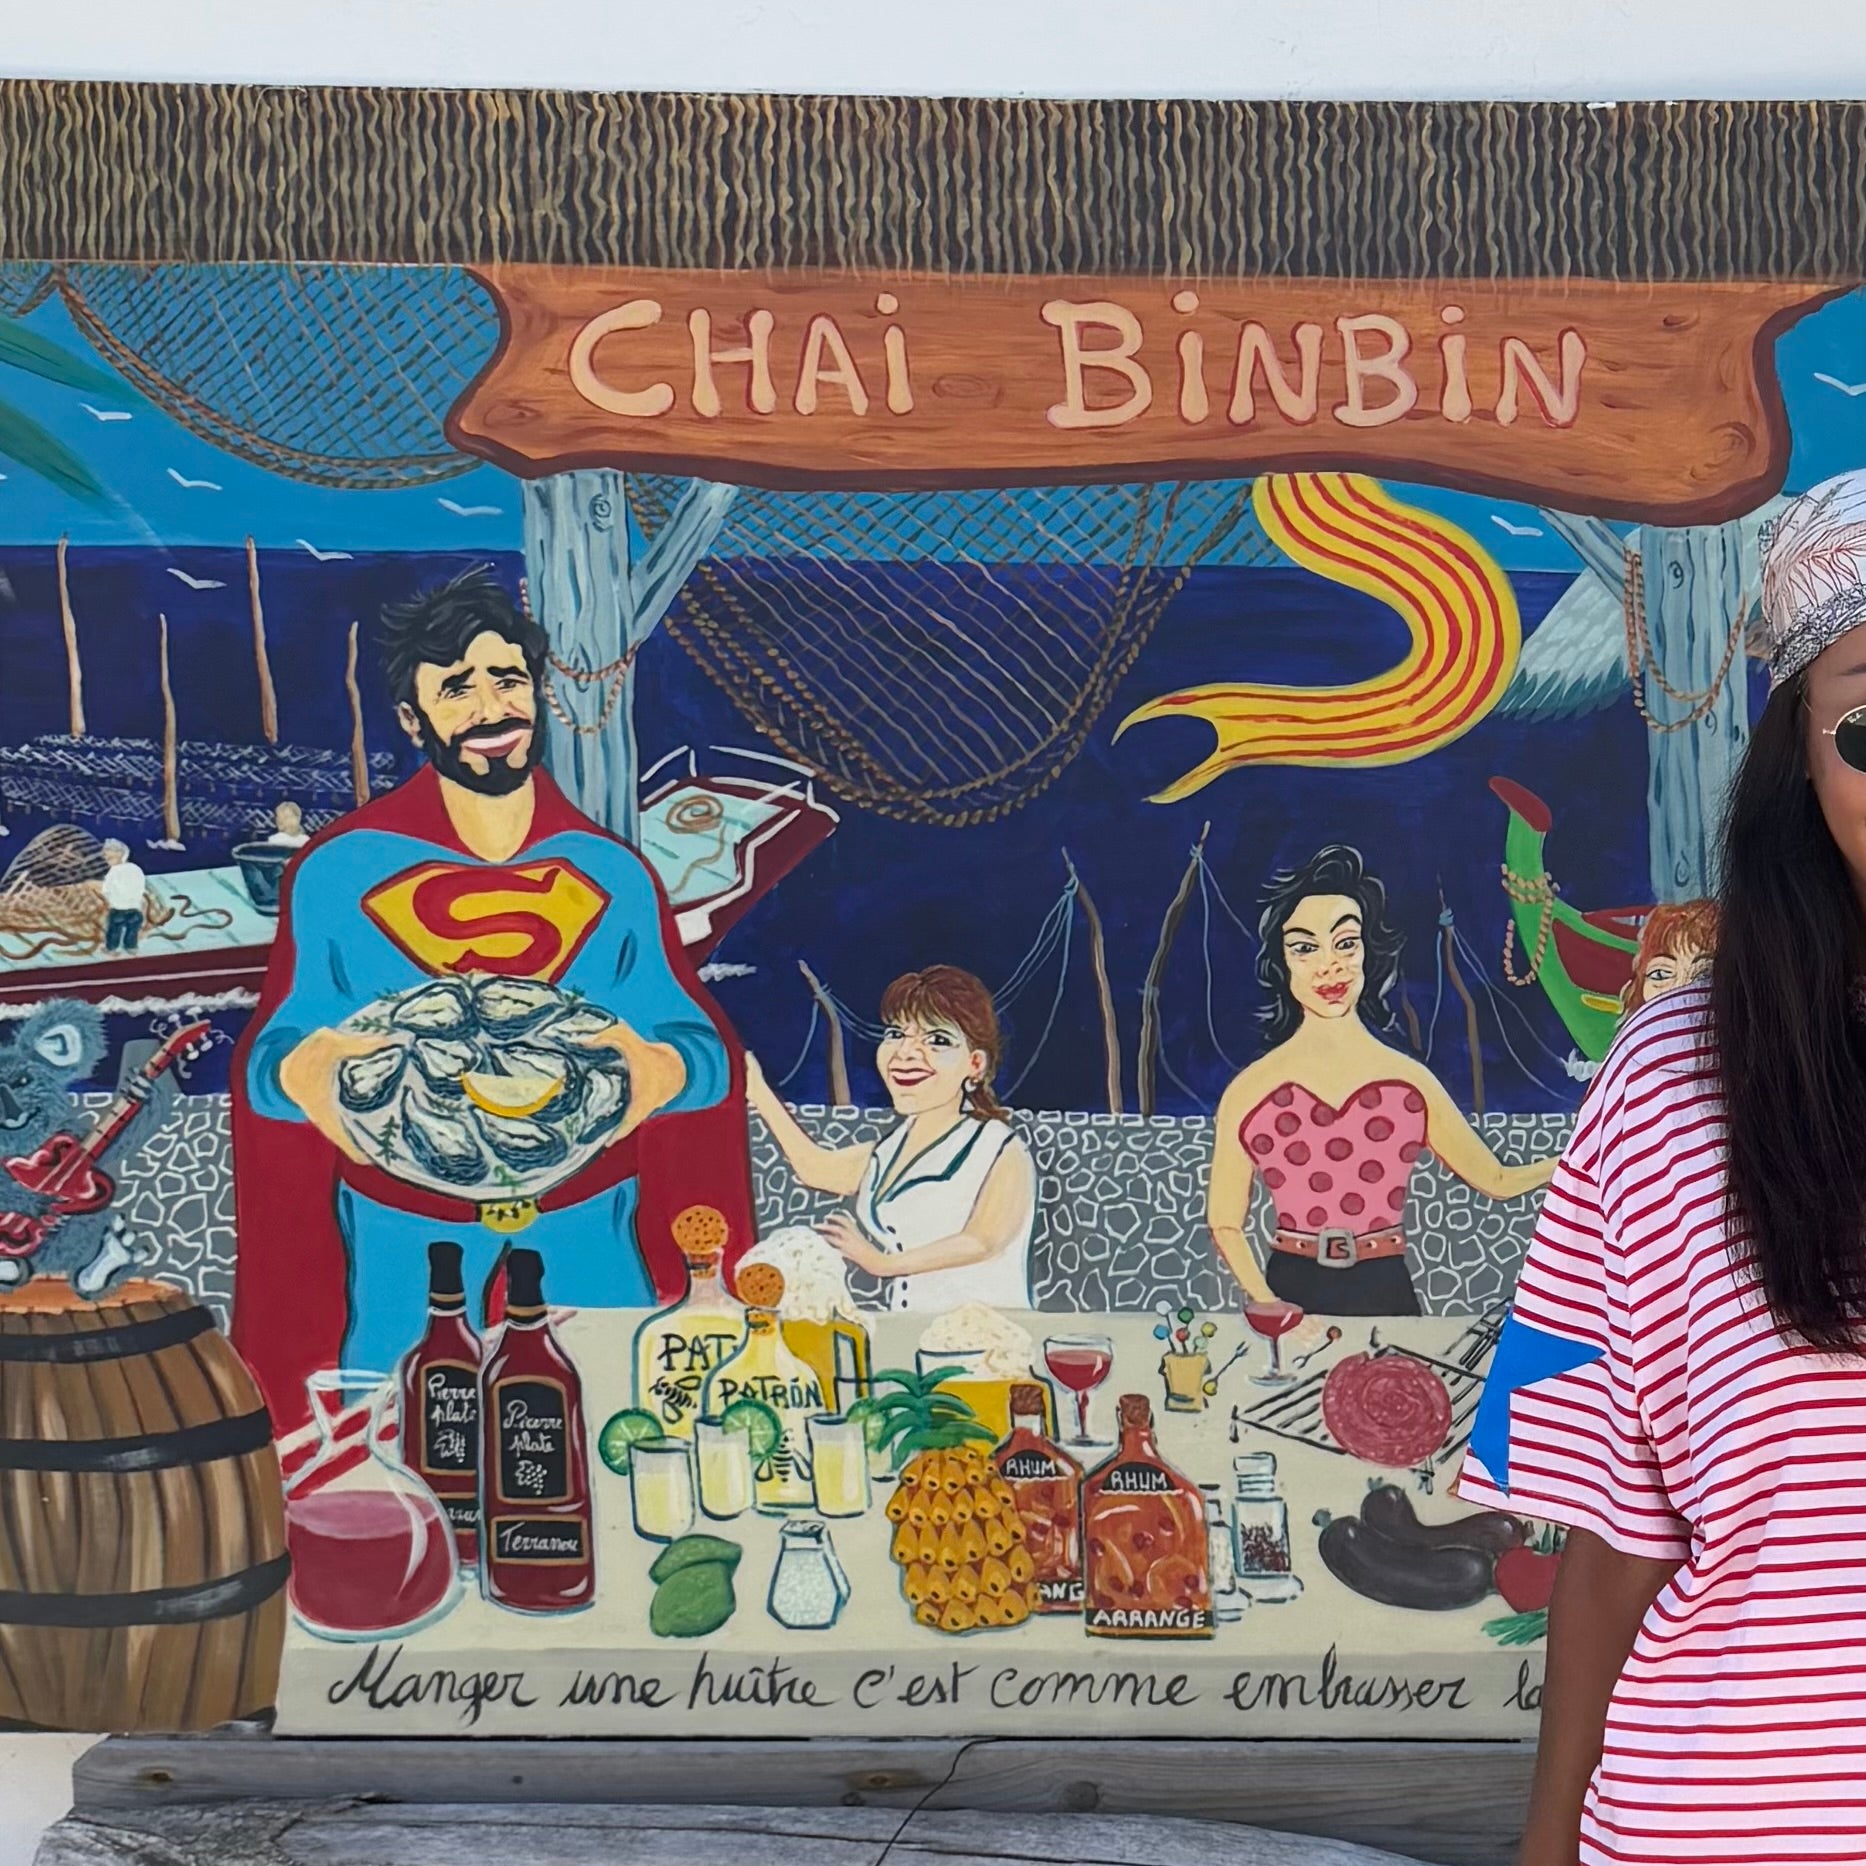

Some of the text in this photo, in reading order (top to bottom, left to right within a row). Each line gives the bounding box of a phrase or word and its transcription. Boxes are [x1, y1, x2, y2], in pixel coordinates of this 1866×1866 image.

[656, 1333, 741, 1371] PAT
[509, 1431, 555, 1458] plate
[1005, 1458, 1057, 1475] RHUM
[1110, 1470, 1168, 1491] RHUM
[327, 1643, 538, 1726] Manger
[558, 1667, 677, 1710] une
[686, 1651, 836, 1710] huître
[990, 1665, 1201, 1708] comme
[1222, 1641, 1476, 1713] embrasser
